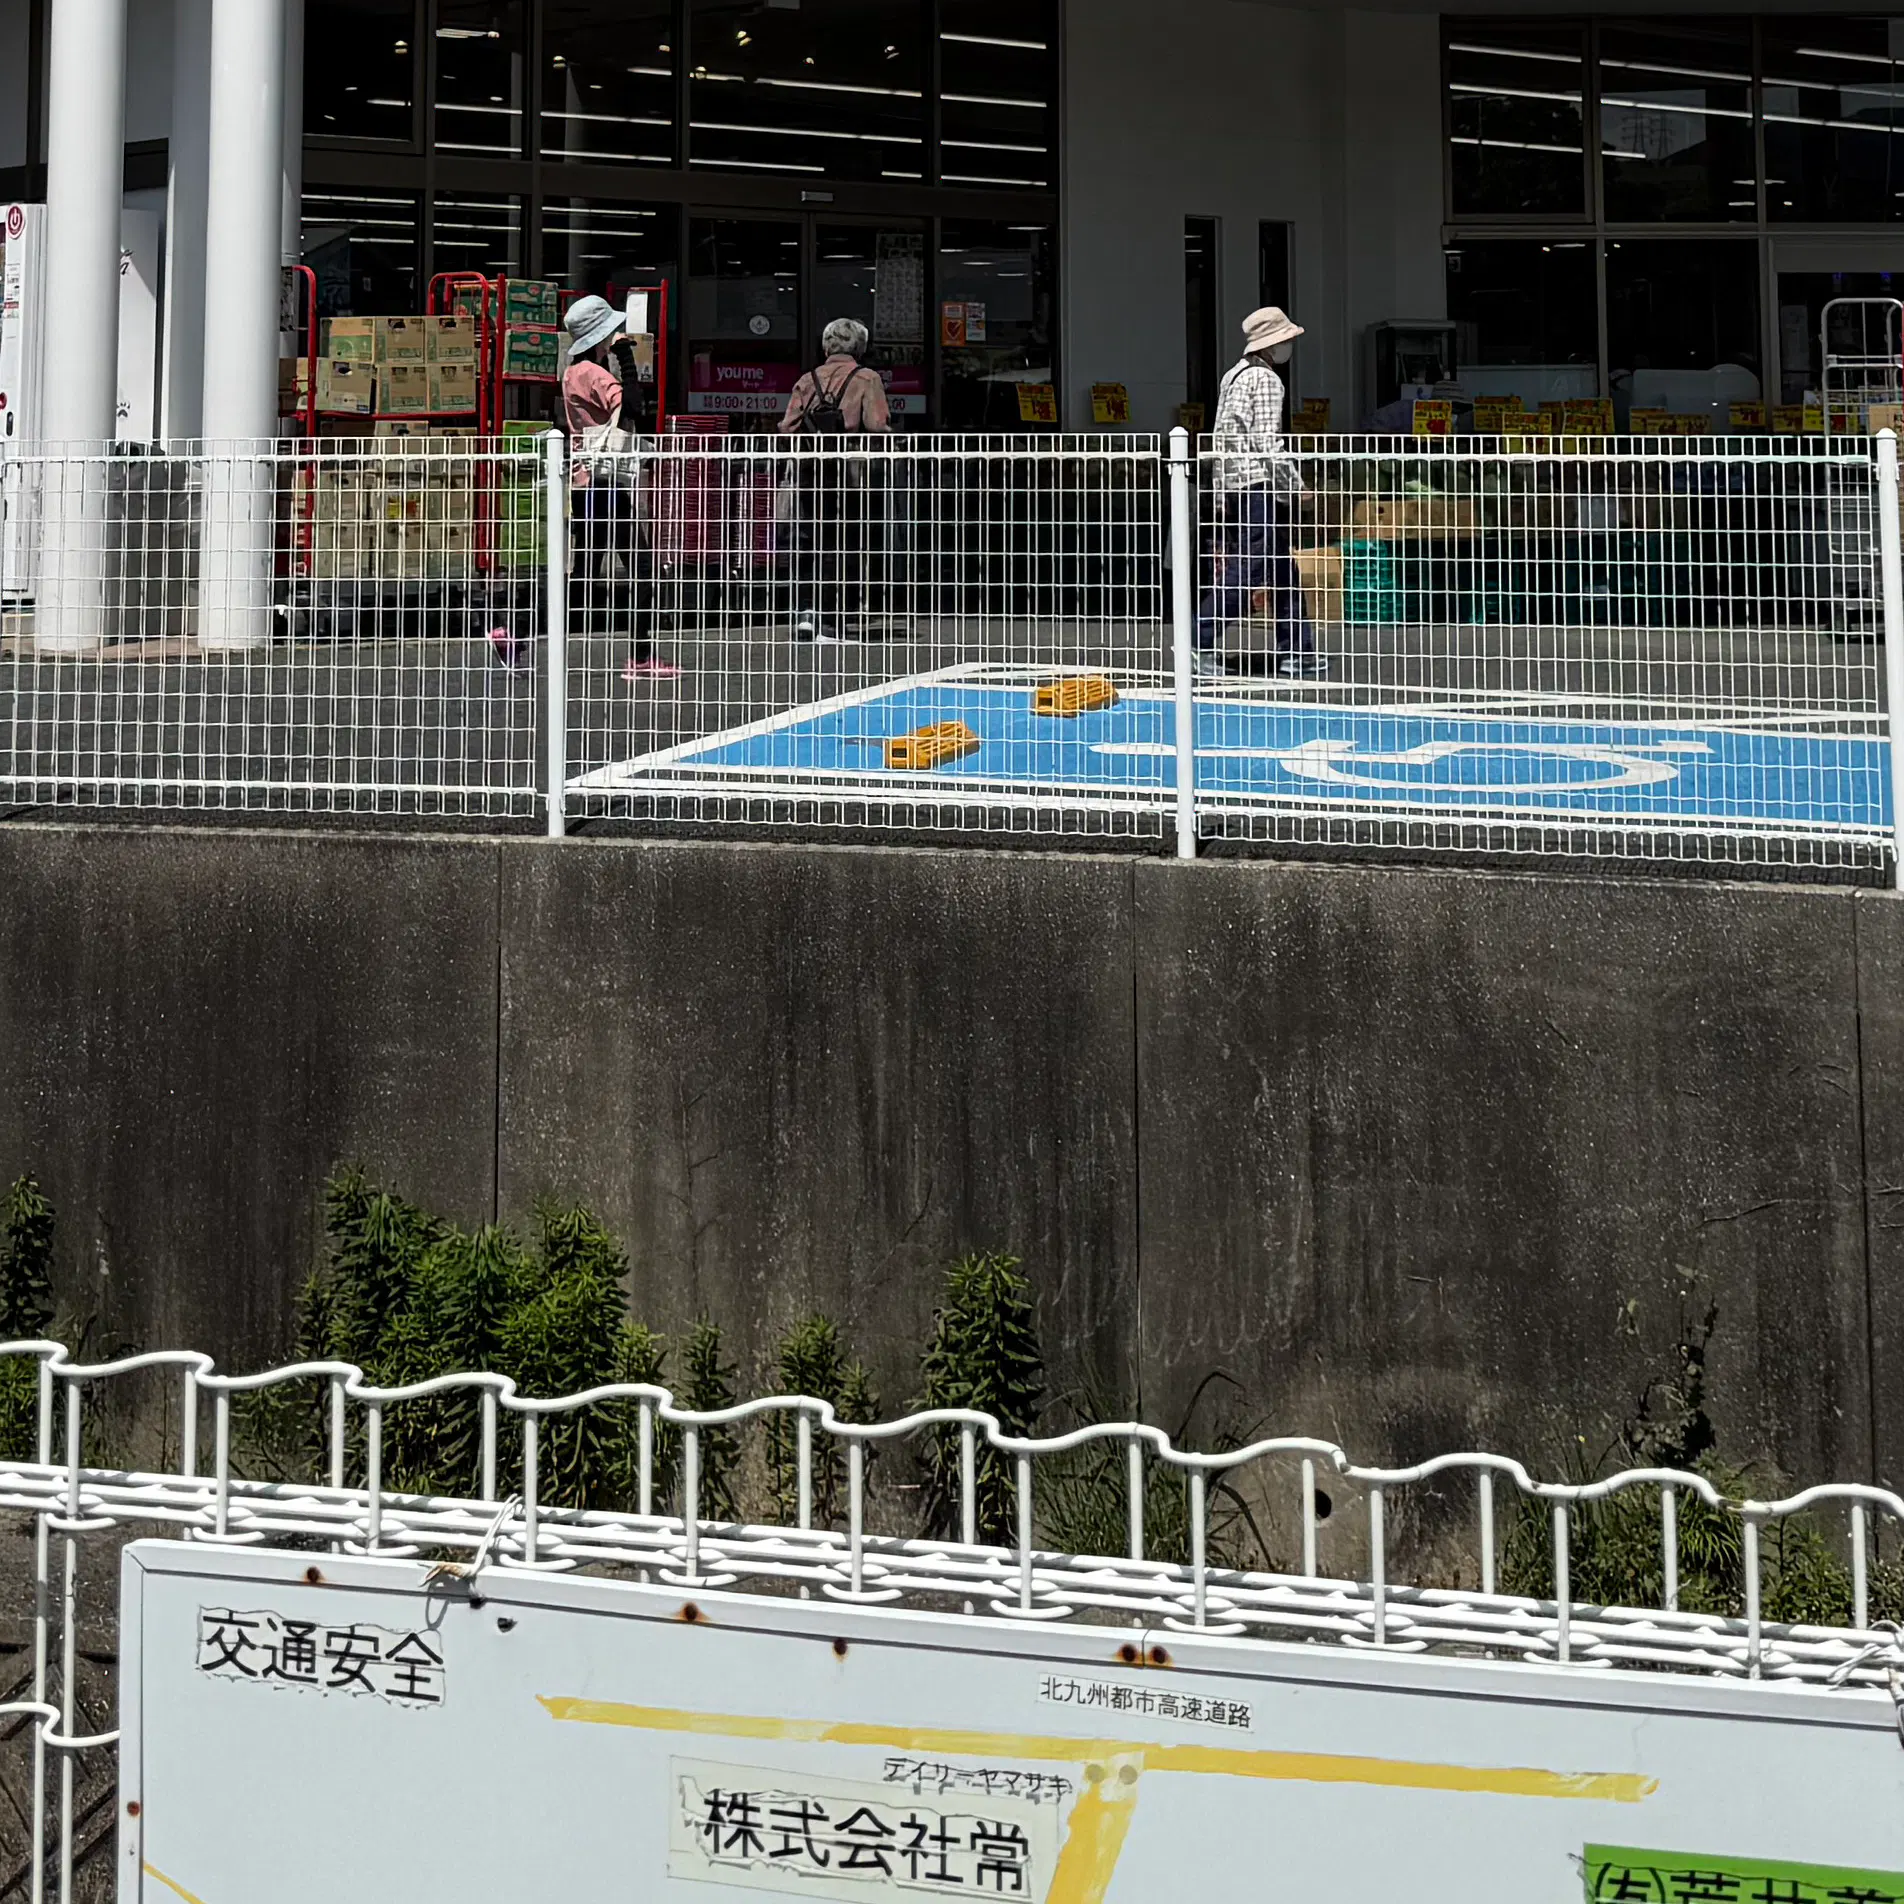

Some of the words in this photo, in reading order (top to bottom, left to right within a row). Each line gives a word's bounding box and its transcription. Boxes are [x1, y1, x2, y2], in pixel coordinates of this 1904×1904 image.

[716, 366, 765, 382] youme
[746, 396, 777, 410] 21:00
[201, 1609, 444, 1704] 交通安全
[1040, 1676, 1252, 1728] 北九州都市高速道路
[703, 1787, 1029, 1892] 株式会社常
